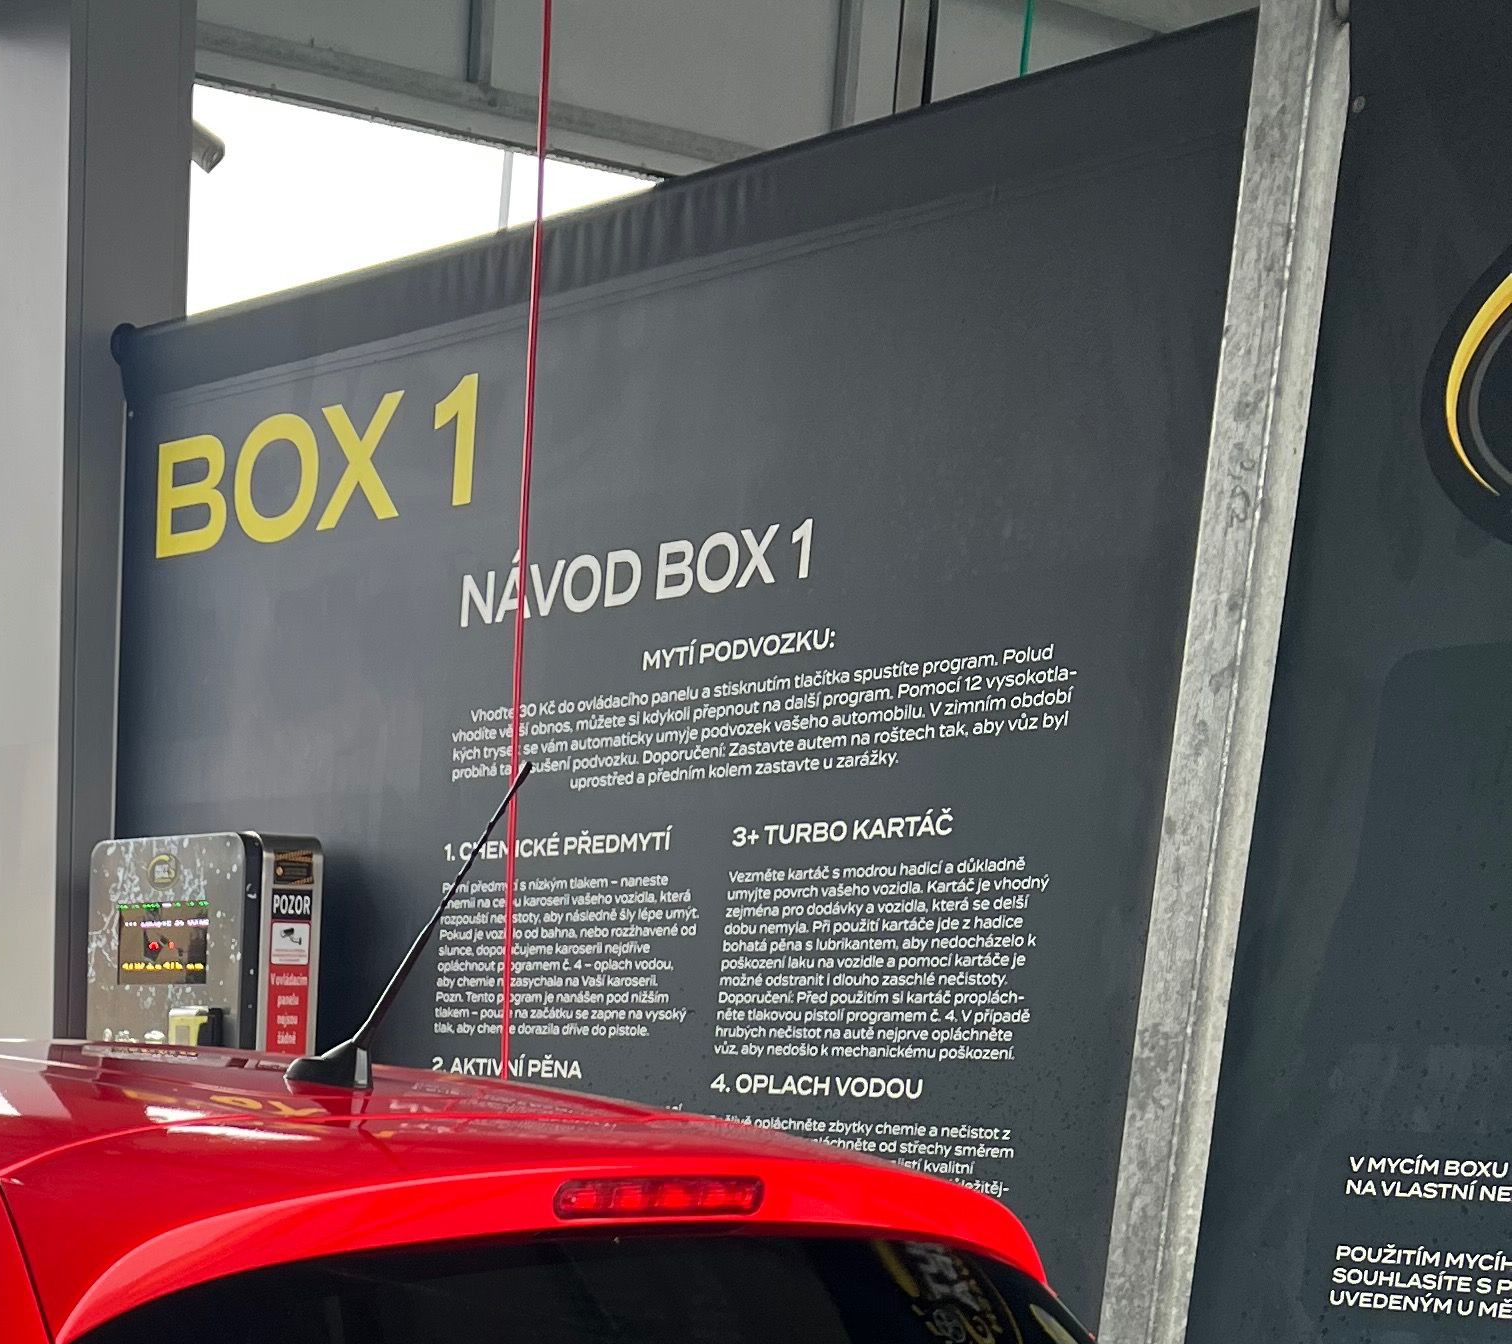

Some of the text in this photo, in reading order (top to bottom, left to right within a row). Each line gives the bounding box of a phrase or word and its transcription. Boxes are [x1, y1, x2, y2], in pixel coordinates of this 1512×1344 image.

[156, 372, 479, 560] BOX 1
[459, 517, 814, 628] NÁVOD BOX 1
[642, 626, 837, 671] MYTÍ PODVOZKU:
[576, 689, 649, 712] ovládacího
[650, 683, 699, 708] panelu
[712, 673, 791, 697] stisknutím
[792, 666, 850, 688] tlačítka
[852, 659, 919, 684] spustíte
[921, 654, 999, 677] program.
[1001, 643, 1053, 664] Polud
[450, 725, 497, 745] vhodíte
[497, 720, 529, 740] věší
[530, 719, 574, 737] obnos,
[575, 711, 626, 732] můžete
[641, 703, 691, 727] kdykoli
[692, 696, 760, 723] přepnout
[783, 690, 820, 710] další
[822, 687, 894, 710] program.
[896, 675, 960, 697] Pomocí
[984, 664, 1077, 691] vysokotla-
[451, 744, 481, 766] kých
[482, 740, 521, 763] tryse
[539, 737, 569, 754] vám
[569, 728, 653, 751] automaticky
[654, 724, 699, 745] umyje
[700, 716, 771, 742] podvozek
[772, 711, 829, 731] vašeho
[830, 702, 926, 726] automobilu.
[943, 694, 1007, 715] zimním
[1009, 686, 1071, 708] období
[451, 761, 498, 786] probíhá
[571, 749, 640, 775] podvozku.
[641, 741, 726, 767] Doporučení:
[728, 735, 795, 756] Zastavte
[796, 732, 847, 750] autem
[873, 722, 935, 743] roštech
[937, 719, 969, 738] tak,
[971, 716, 1004, 736] aby
[1006, 713, 1038, 731] vůz
[1041, 709, 1068, 731] byl
[568, 768, 634, 793] uprostřed
[647, 763, 706, 788] předním
[707, 760, 752, 779] kolem
[754, 754, 820, 775] zastavte
[835, 748, 899, 768] zarážky.
[731, 807, 954, 848] 3+ TURBO KARTÁČ
[443, 842, 456, 862] 1.
[563, 824, 674, 856] PŘEDMYTÍ
[727, 866, 786, 883] Vezměte
[786, 864, 830, 880] kartáč
[841, 862, 897, 878] modrou
[898, 859, 942, 875] hadicí
[955, 855, 1026, 873] důkladně
[726, 884, 771, 904] umyjte
[772, 882, 819, 903] povrch
[819, 881, 870, 897] vašeho
[871, 878, 924, 895] vozidla.
[926, 876, 975, 893] Kartáč
[992, 873, 1049, 892] vhodný
[272, 893, 312, 915] POZOR
[725, 902, 780, 922] zejména
[781, 904, 805, 920] pro
[805, 899, 864, 918] dodávky
[876, 897, 929, 914] vozidla,
[931, 895, 969, 911] která
[991, 893, 1028, 909] delší
[527, 1054, 583, 1079] PĚNA
[709, 1072, 925, 1100] 4. OPLACH VODOU
[827, 1118, 873, 1137] zbytky
[873, 1120, 926, 1136] chemie
[939, 1123, 1000, 1139] nečistot
[898, 1138, 952, 1159] střechy
[953, 1142, 1014, 1159] směrem
[922, 1157, 974, 1174] kvalitní
[1349, 1154, 1509, 1179] V MYCÍM BOXU
[1345, 1179, 1377, 1196] NA
[1380, 1179, 1477, 1201] VLASTNÍ
[1335, 1243, 1441, 1268] POUŽITÍM
[1332, 1267, 1473, 1294] SOUHLASÍTE
[1475, 1277, 1492, 1295] S
[1329, 1289, 1454, 1315] UVEDENÝM
[1457, 1299, 1474, 1317] U
